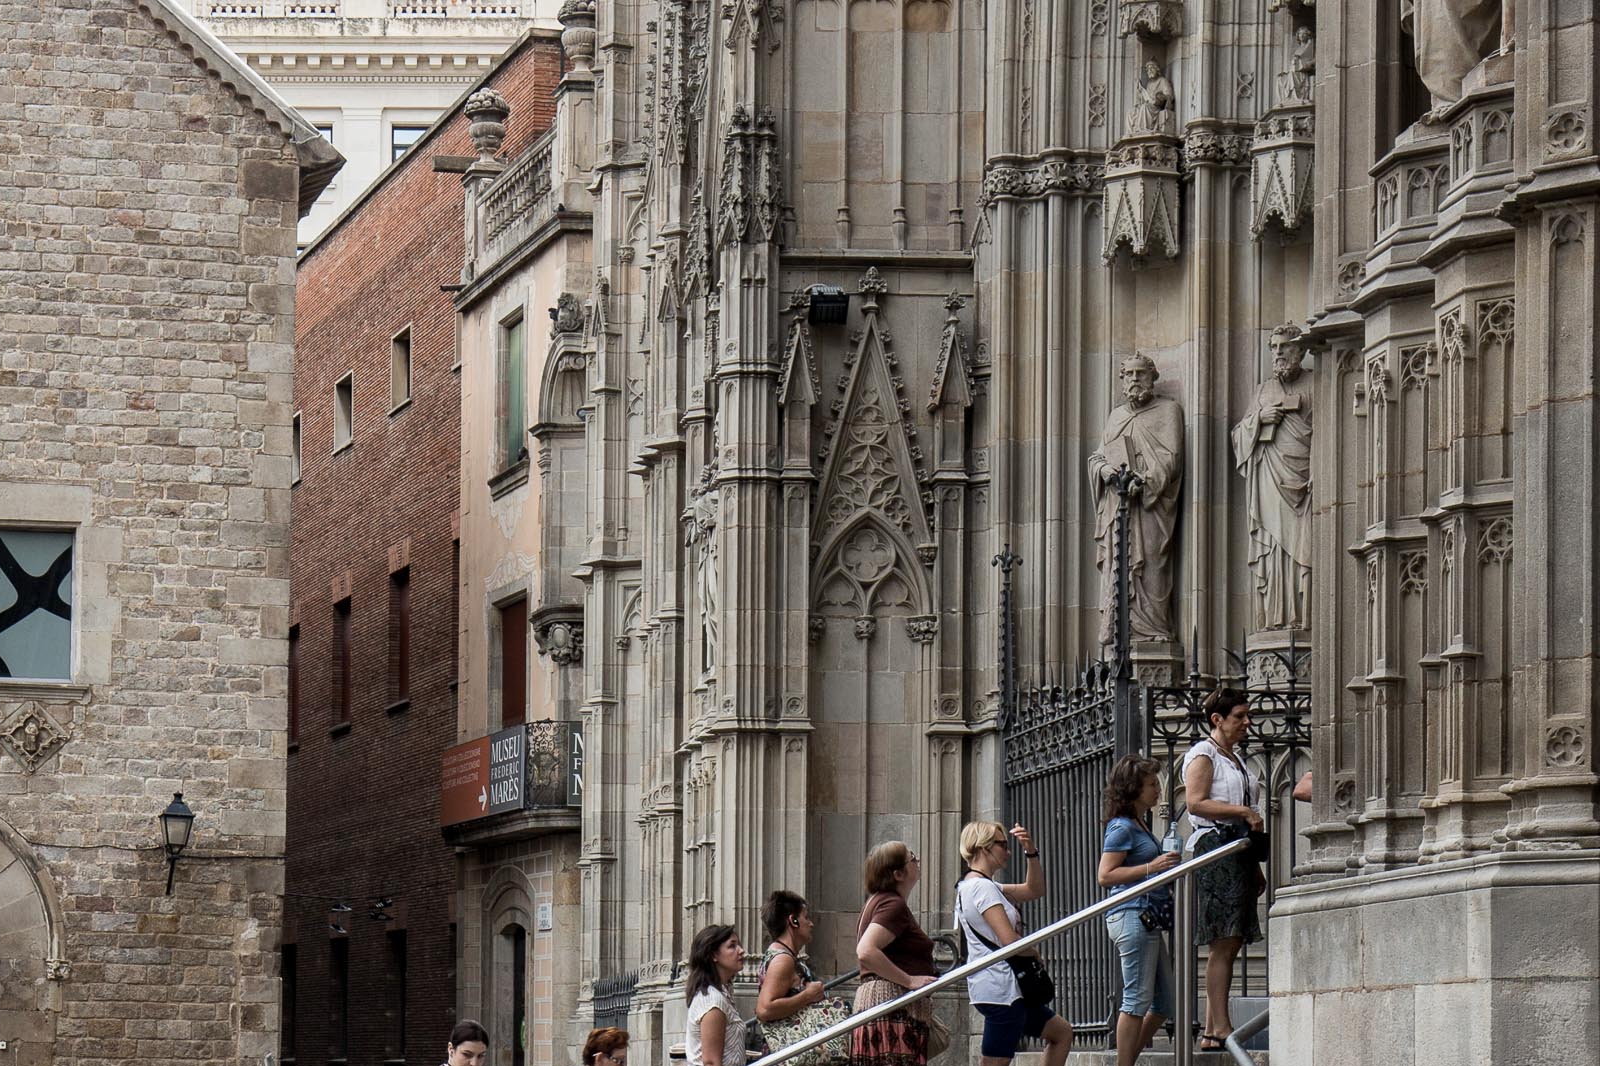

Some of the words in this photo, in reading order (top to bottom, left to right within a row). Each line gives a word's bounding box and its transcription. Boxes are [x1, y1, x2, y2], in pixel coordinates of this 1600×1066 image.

[490, 735, 521, 765] MUSEU
[490, 761, 520, 781] FREDERIC
[490, 775, 520, 807] MARÈS
